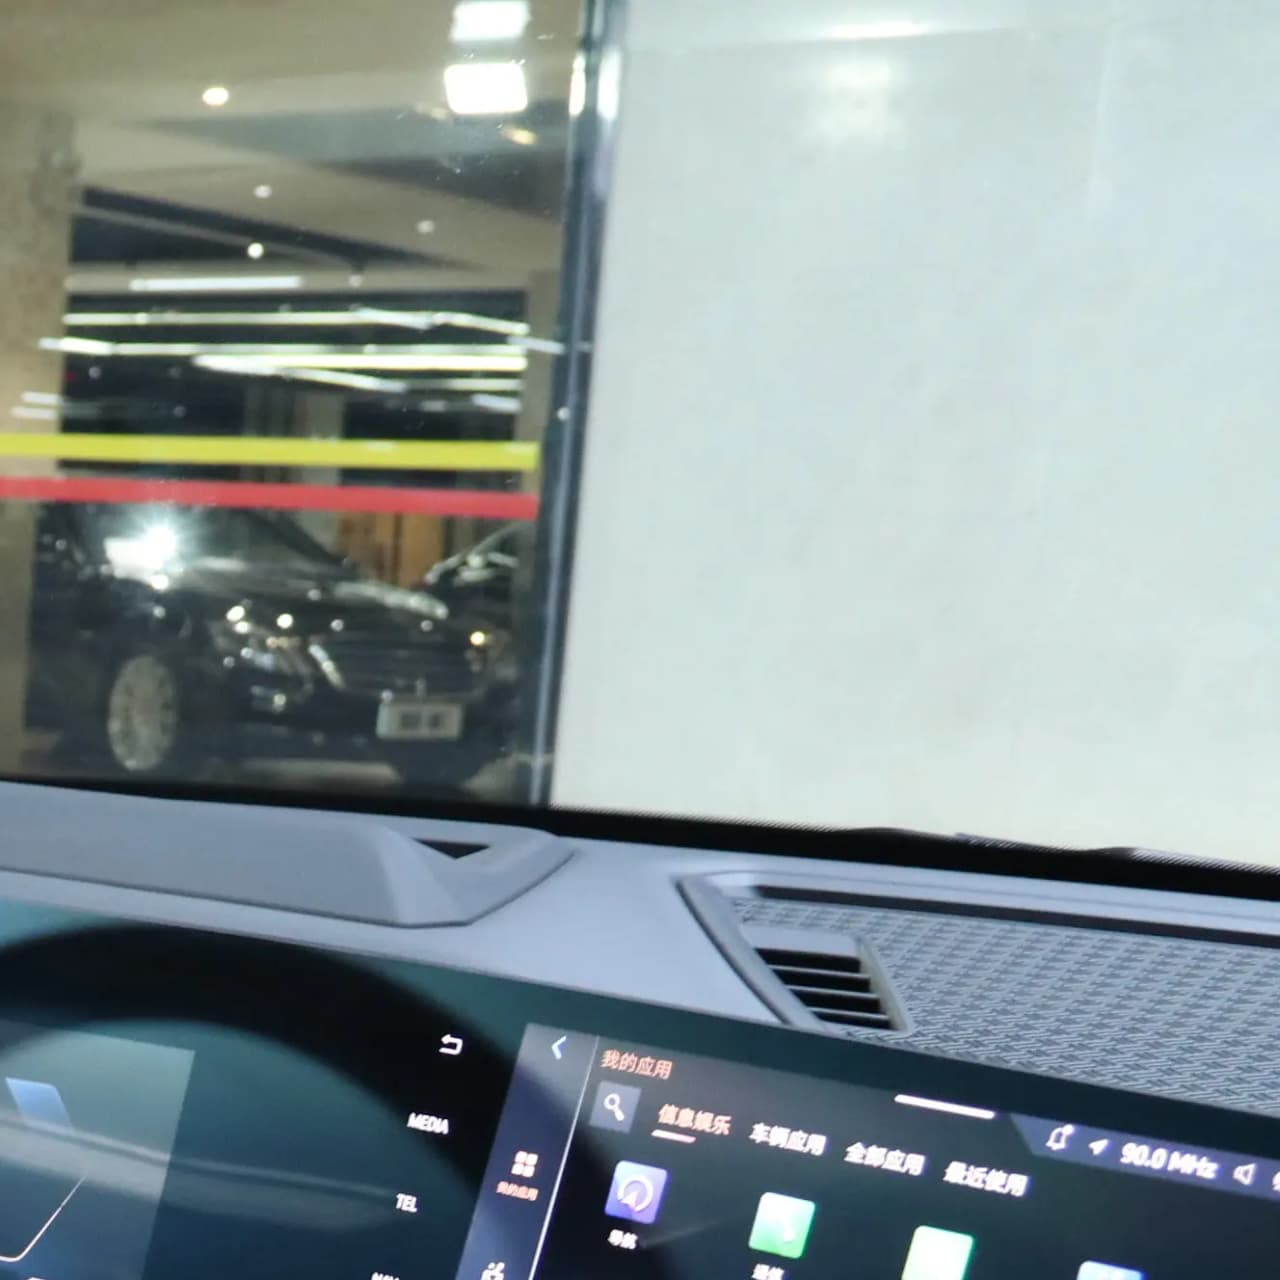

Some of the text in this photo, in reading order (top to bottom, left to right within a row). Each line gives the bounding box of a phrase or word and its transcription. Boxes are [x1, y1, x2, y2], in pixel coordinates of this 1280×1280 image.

[600, 1048, 673, 1080] 我的应用
[407, 1112, 449, 1135] MEDIA
[657, 1103, 1029, 1197] 信息娱乐 车辆应用 全部应用 最近使用
[1167, 1151, 1220, 1179] MHz
[396, 1193, 418, 1213] TEL
